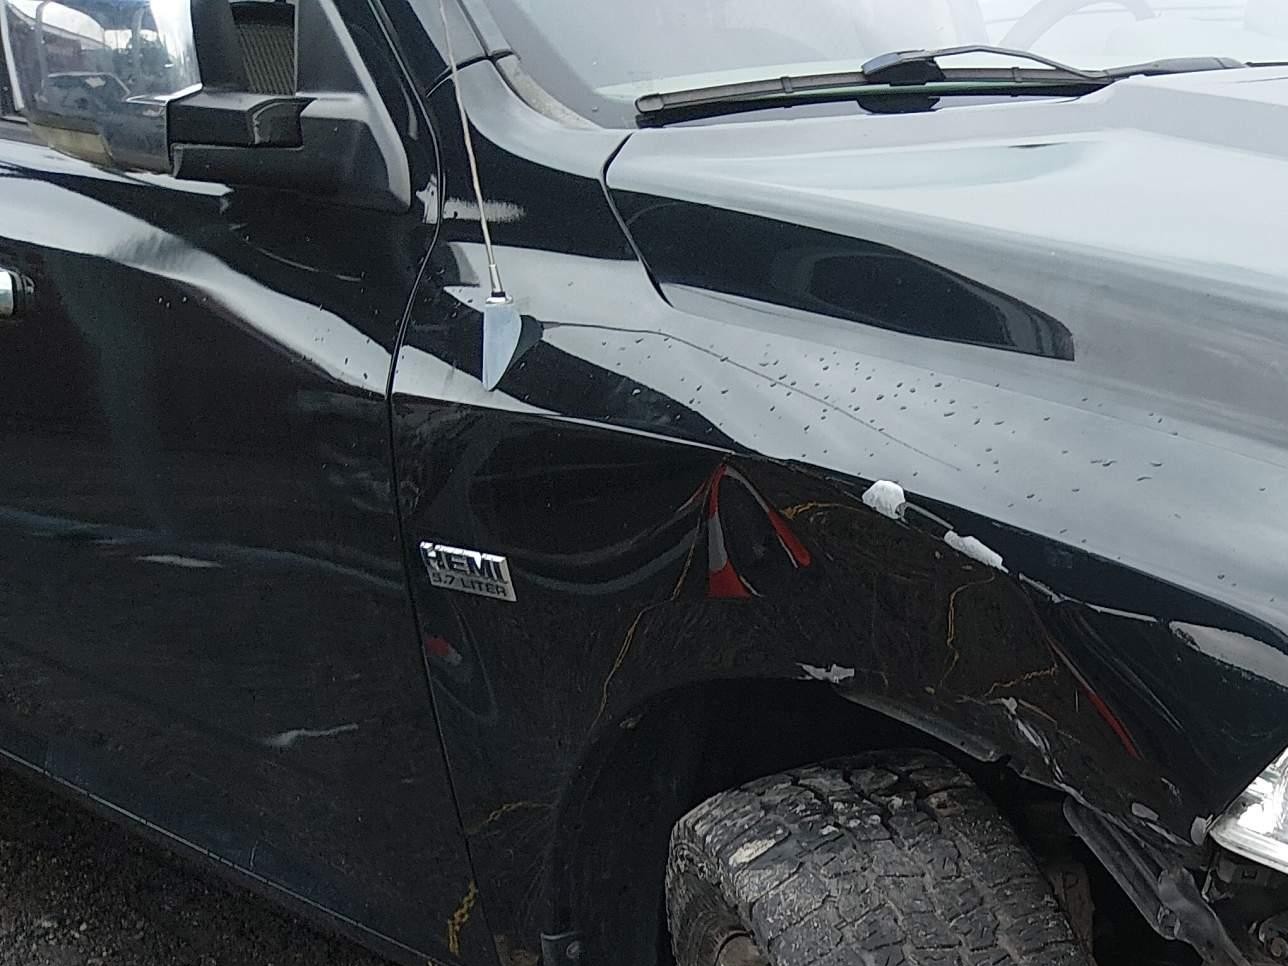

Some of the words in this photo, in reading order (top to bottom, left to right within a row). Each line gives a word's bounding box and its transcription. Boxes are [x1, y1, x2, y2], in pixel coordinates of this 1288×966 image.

[420, 541, 508, 582] HEMI
[432, 572, 456, 586] 5.7
[461, 578, 508, 597] LITER
